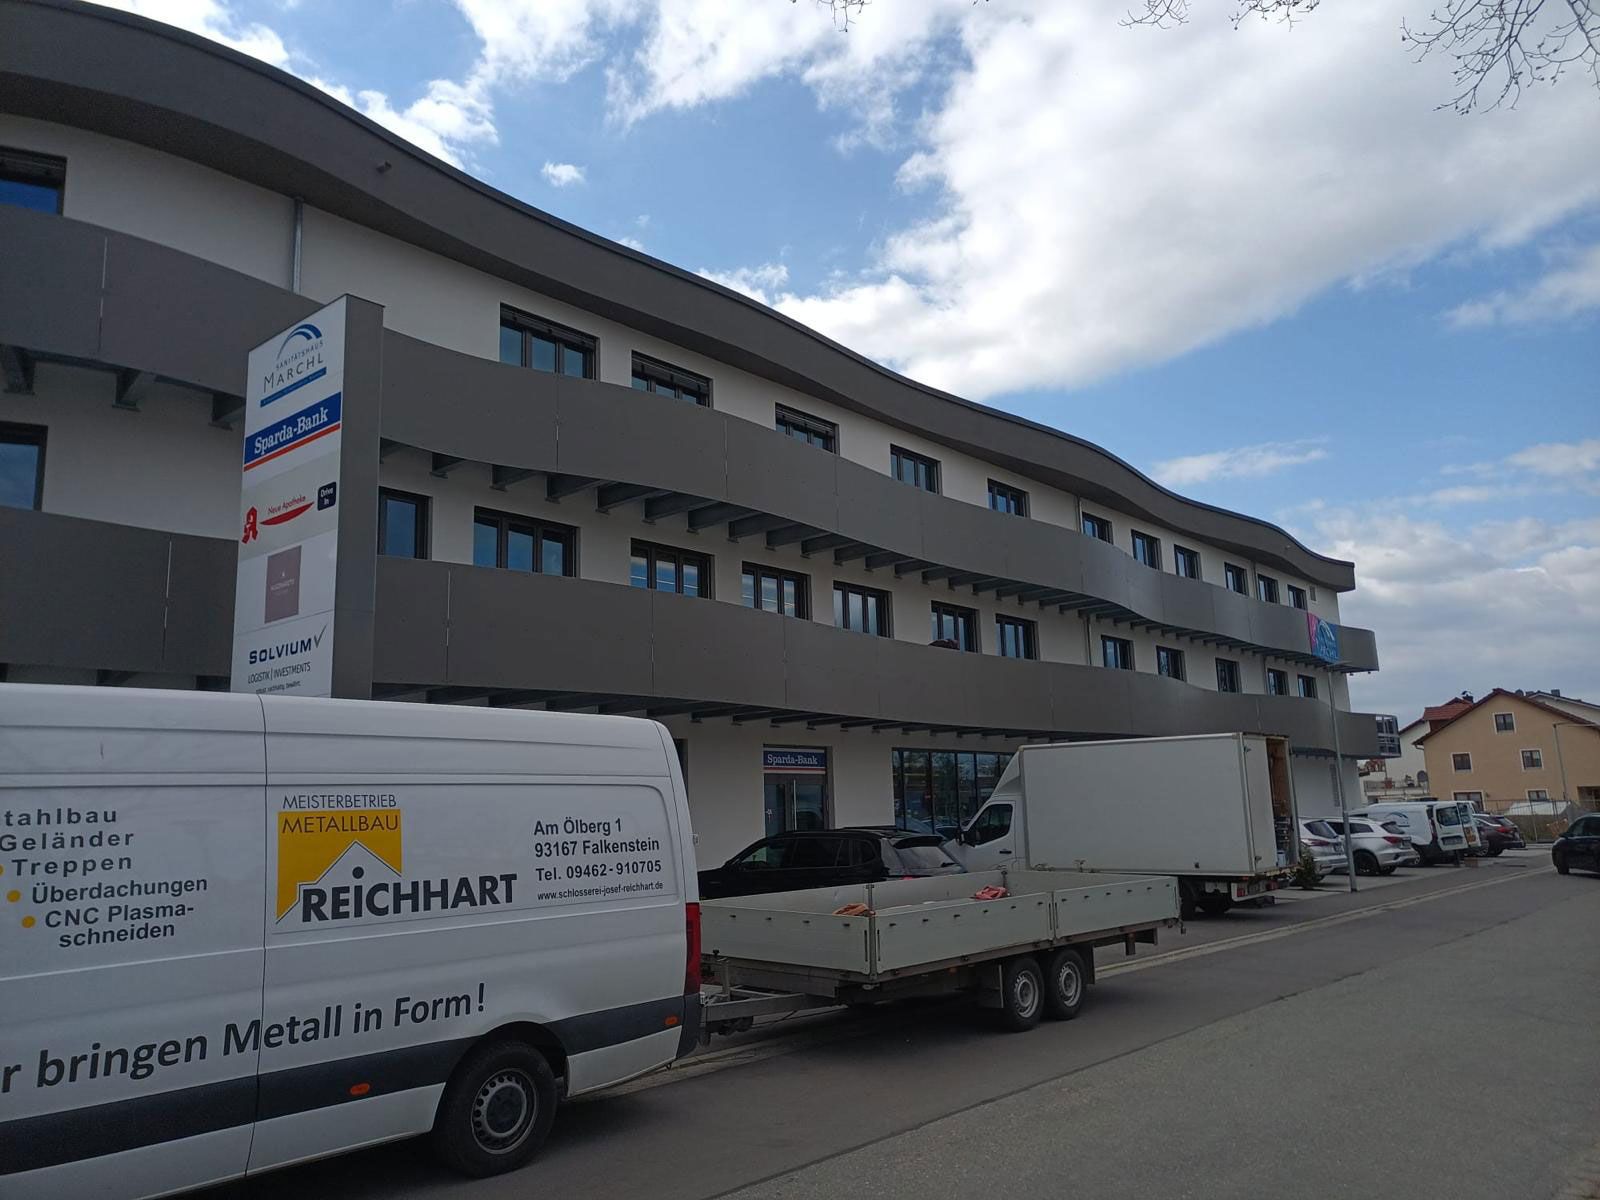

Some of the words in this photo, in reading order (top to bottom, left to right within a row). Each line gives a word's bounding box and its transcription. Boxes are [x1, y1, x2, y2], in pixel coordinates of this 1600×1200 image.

[263, 353, 324, 393] MARCHL
[254, 407, 328, 455] Sparda-Bank
[320, 487, 334, 498] Drive
[249, 637, 312, 665] SOLVIUM
[248, 669, 271, 684] LOGISTIK
[274, 661, 311, 678] INVESTMENTS
[767, 754, 818, 766] Sparda-Bank
[282, 794, 397, 809] MEISTERBETRIEB
[281, 814, 399, 834] METALLBAU
[534, 821, 559, 835] Am
[563, 816, 611, 836] Ölberg
[615, 818, 622, 833] 1
[0, 831, 134, 852] Geländer
[534, 841, 578, 858] 93167
[582, 837, 660, 855] Falkenstein
[12, 856, 133, 877] Treppen
[535, 867, 562, 881] Tel.
[566, 860, 662, 879] 09462-910705
[32, 878, 208, 904] Überdachungen
[537, 881, 664, 900] www.schlosserei-josef-reichhart.de
[45, 907, 99, 928] CNC
[108, 903, 195, 923] Plasma-
[58, 922, 176, 948] schneiden
[36, 1035, 208, 1088] bringen
[222, 1005, 342, 1056] Metall
[352, 1003, 383, 1033] in
[393, 982, 486, 1027] Form!
